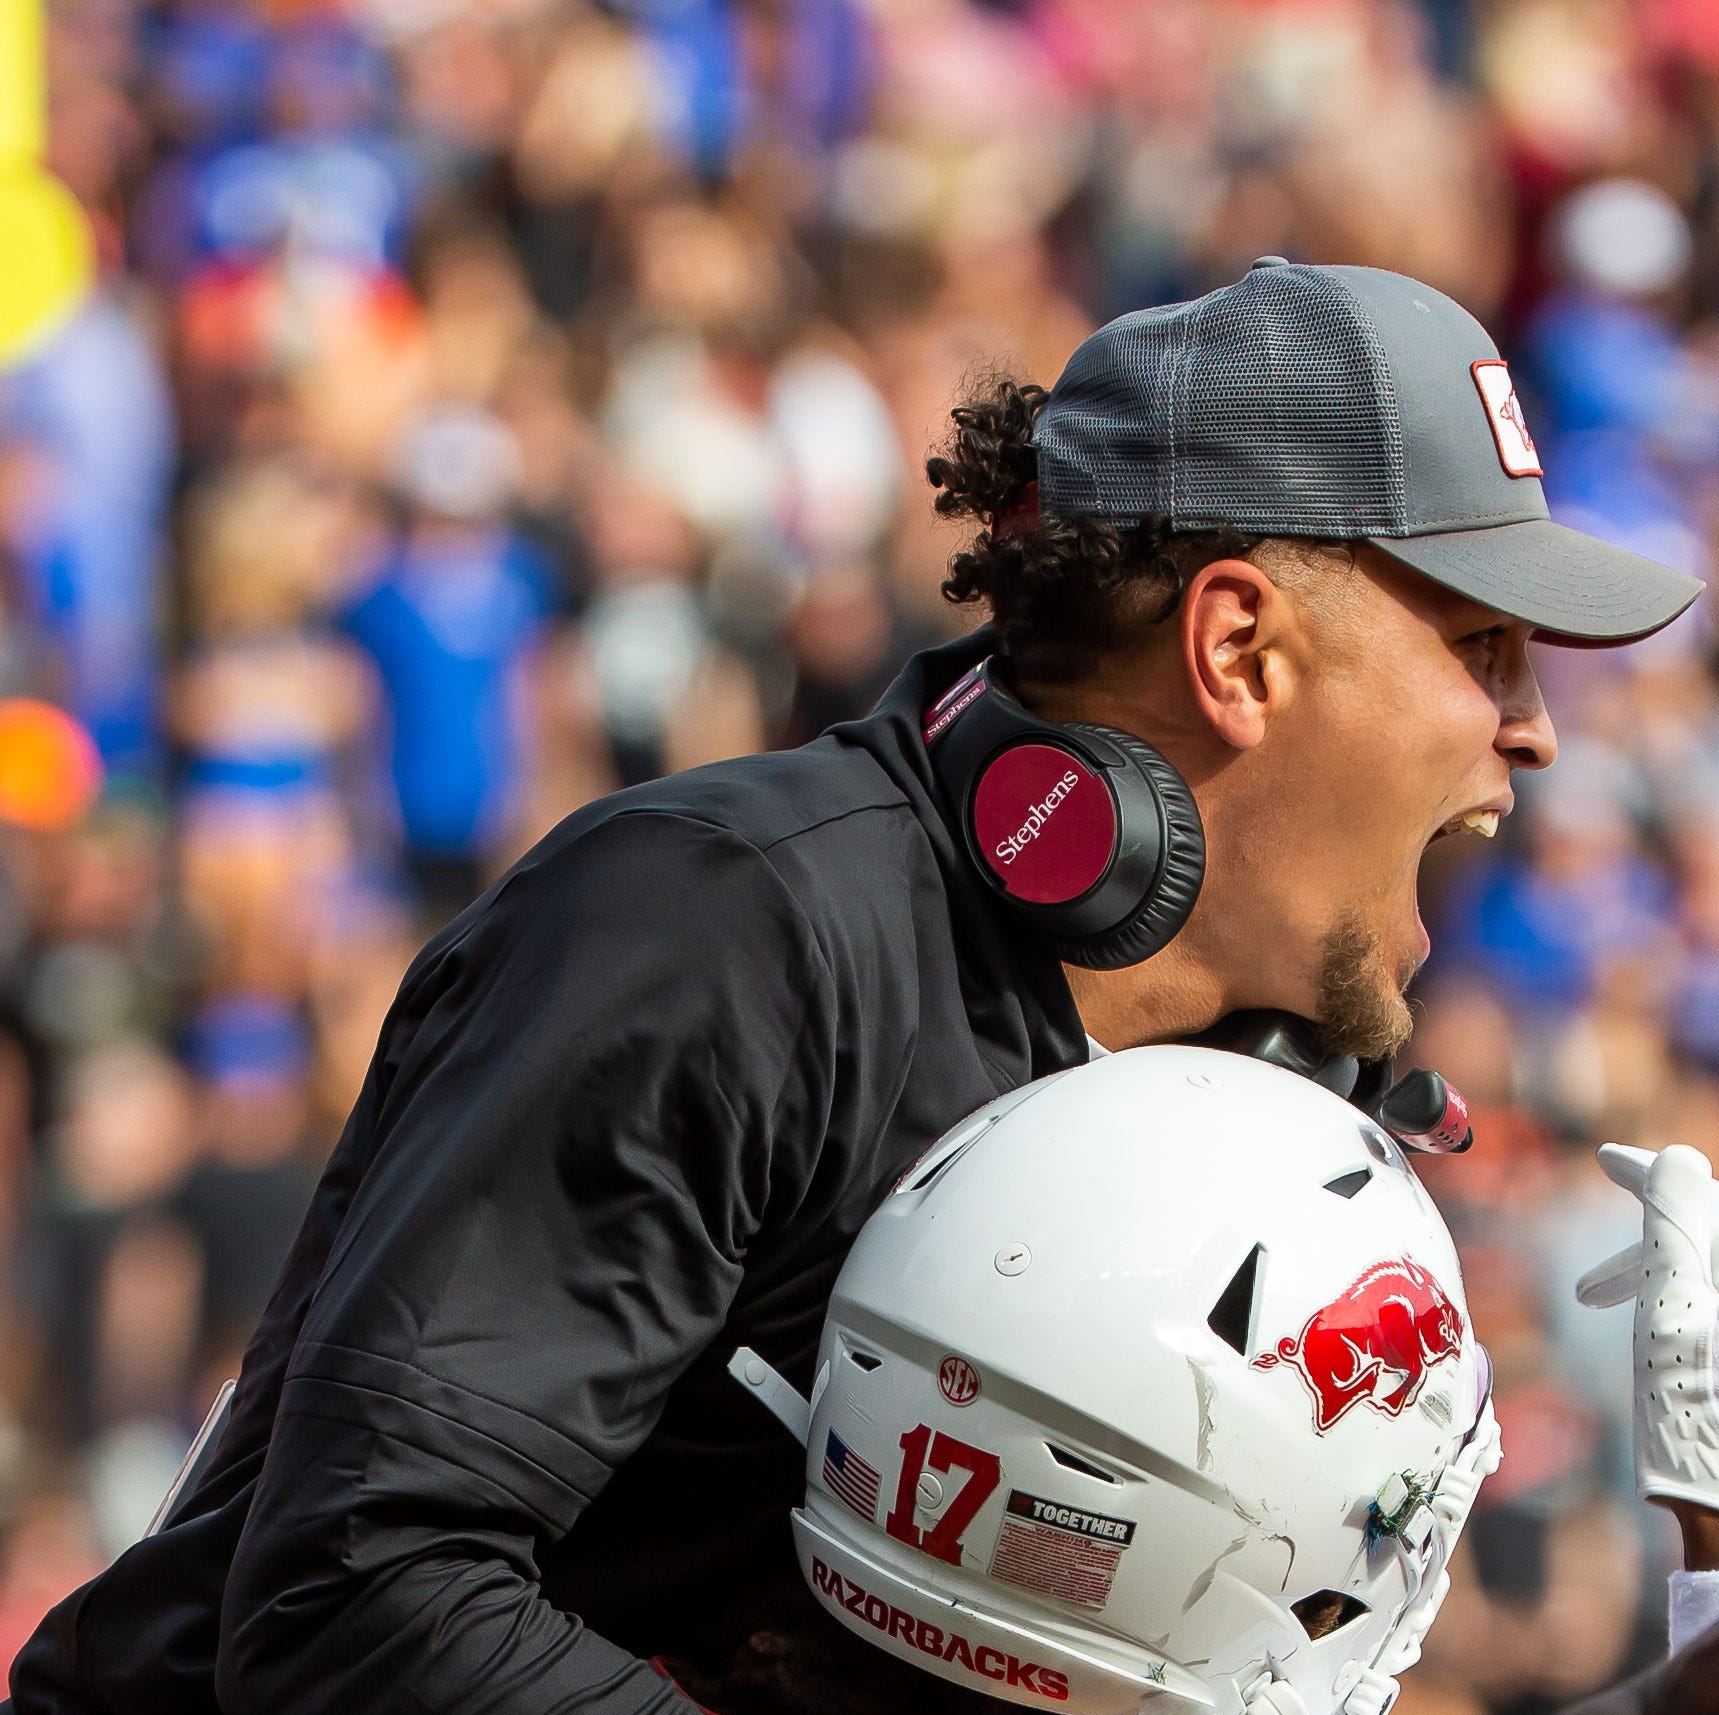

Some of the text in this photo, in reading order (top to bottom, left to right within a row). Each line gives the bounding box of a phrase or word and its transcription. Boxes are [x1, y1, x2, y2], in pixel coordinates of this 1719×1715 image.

[927, 686, 981, 738] Stephens
[995, 769, 1079, 865] Stephens
[941, 1359, 976, 1400] SEC
[886, 1422, 1001, 1567] 17
[1033, 1500, 1128, 1541] TOGETHER
[811, 1554, 1070, 1702] RAZORBACKS
